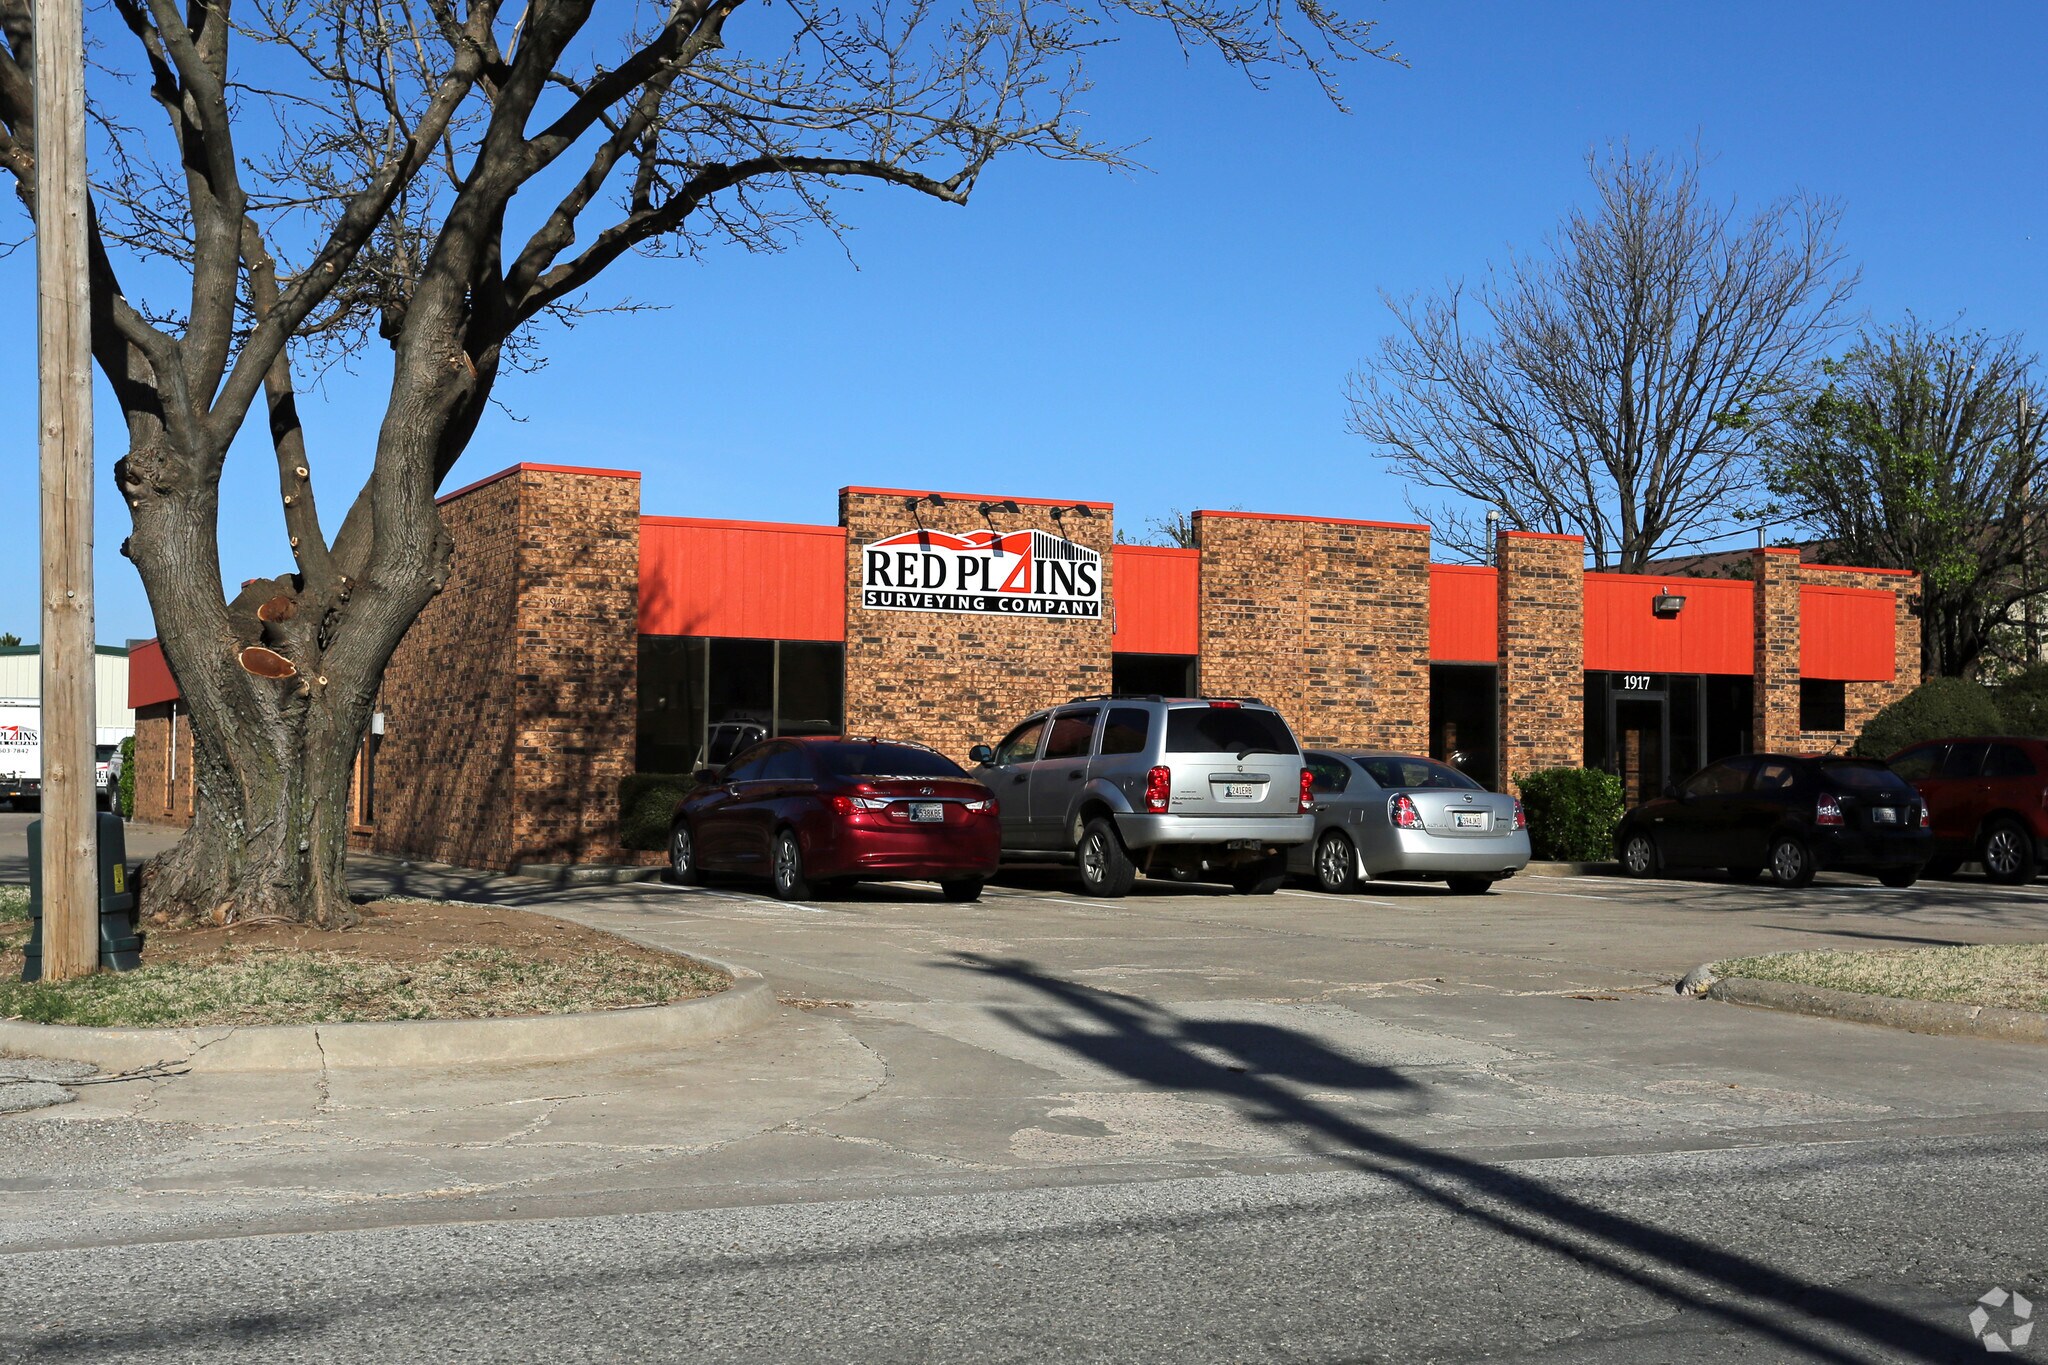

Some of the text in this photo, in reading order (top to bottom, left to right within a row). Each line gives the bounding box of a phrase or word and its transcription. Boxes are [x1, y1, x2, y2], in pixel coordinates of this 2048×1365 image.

[866, 545, 1097, 597] RED PLAINS
[867, 591, 1096, 615] SURVEYING COMPANY
[1623, 675, 1650, 690] 1917
